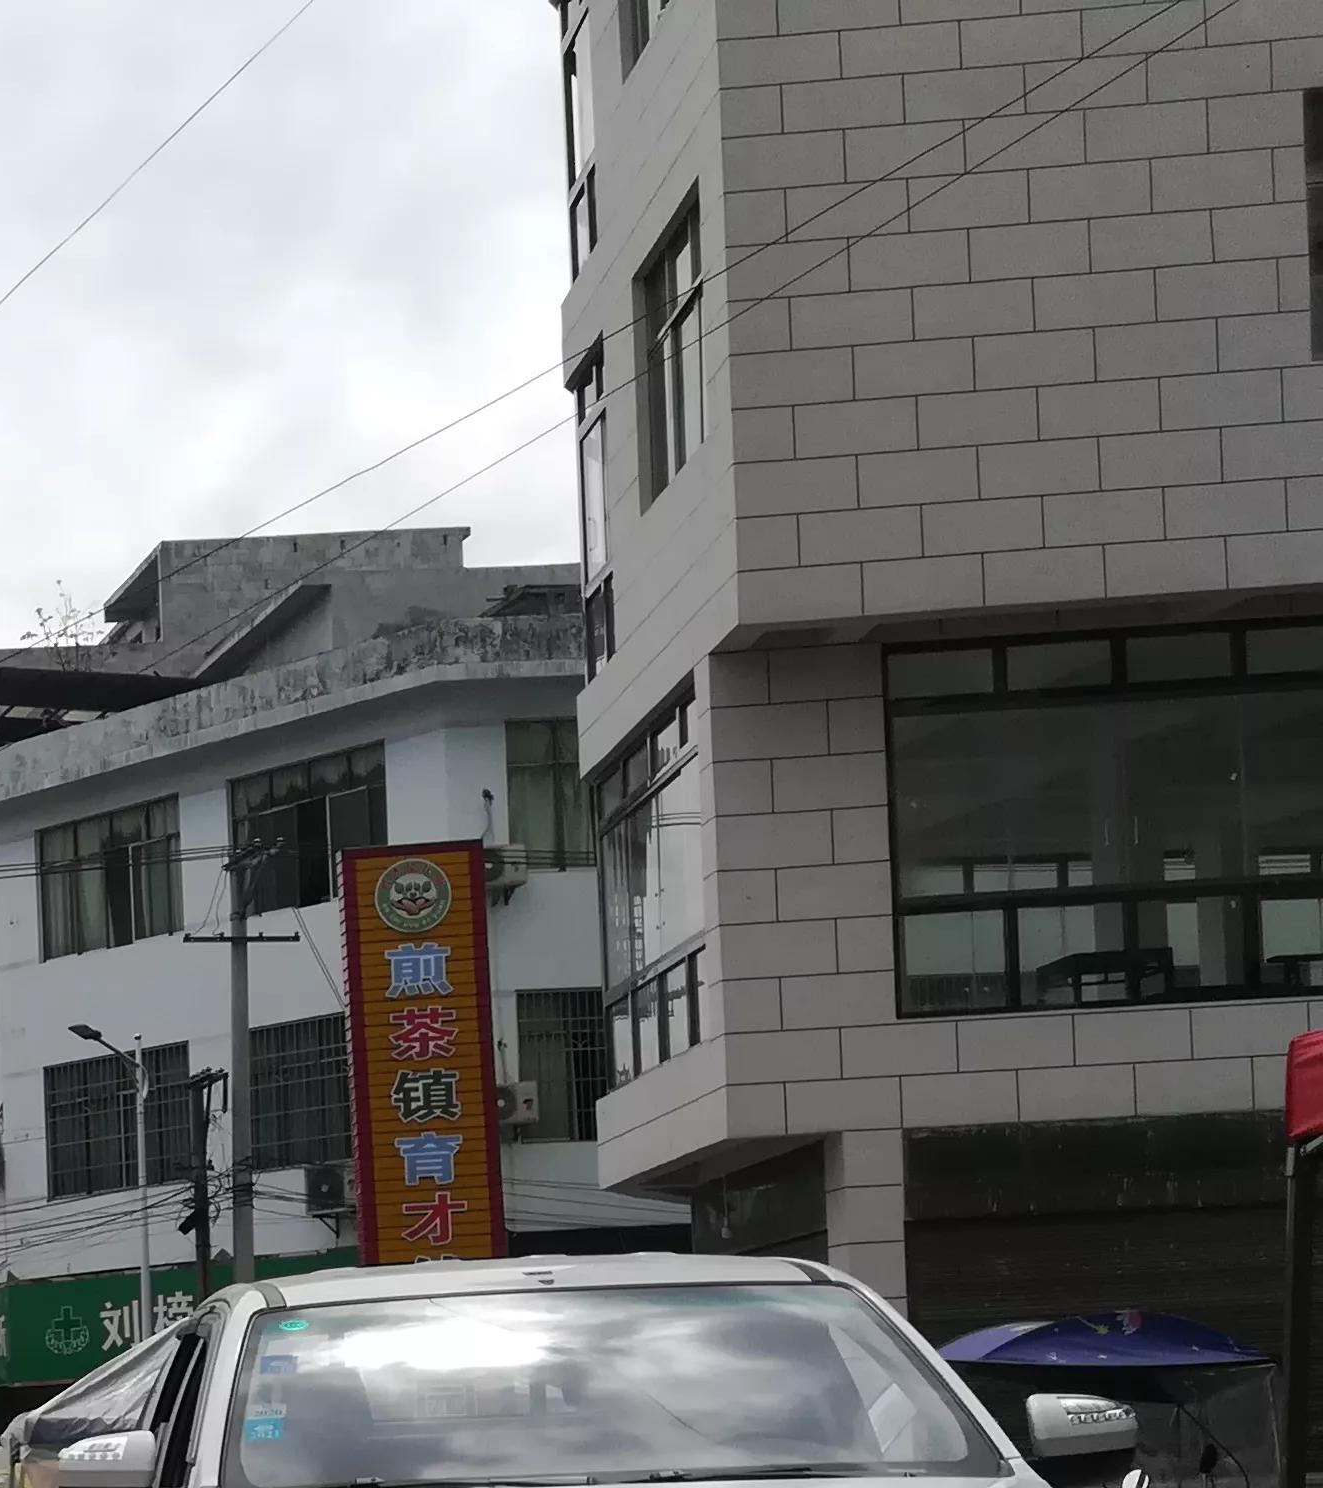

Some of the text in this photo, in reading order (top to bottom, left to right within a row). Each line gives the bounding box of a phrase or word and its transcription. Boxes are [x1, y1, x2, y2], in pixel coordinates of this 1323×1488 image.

[384, 942, 468, 1264] 煎茶镇育才
